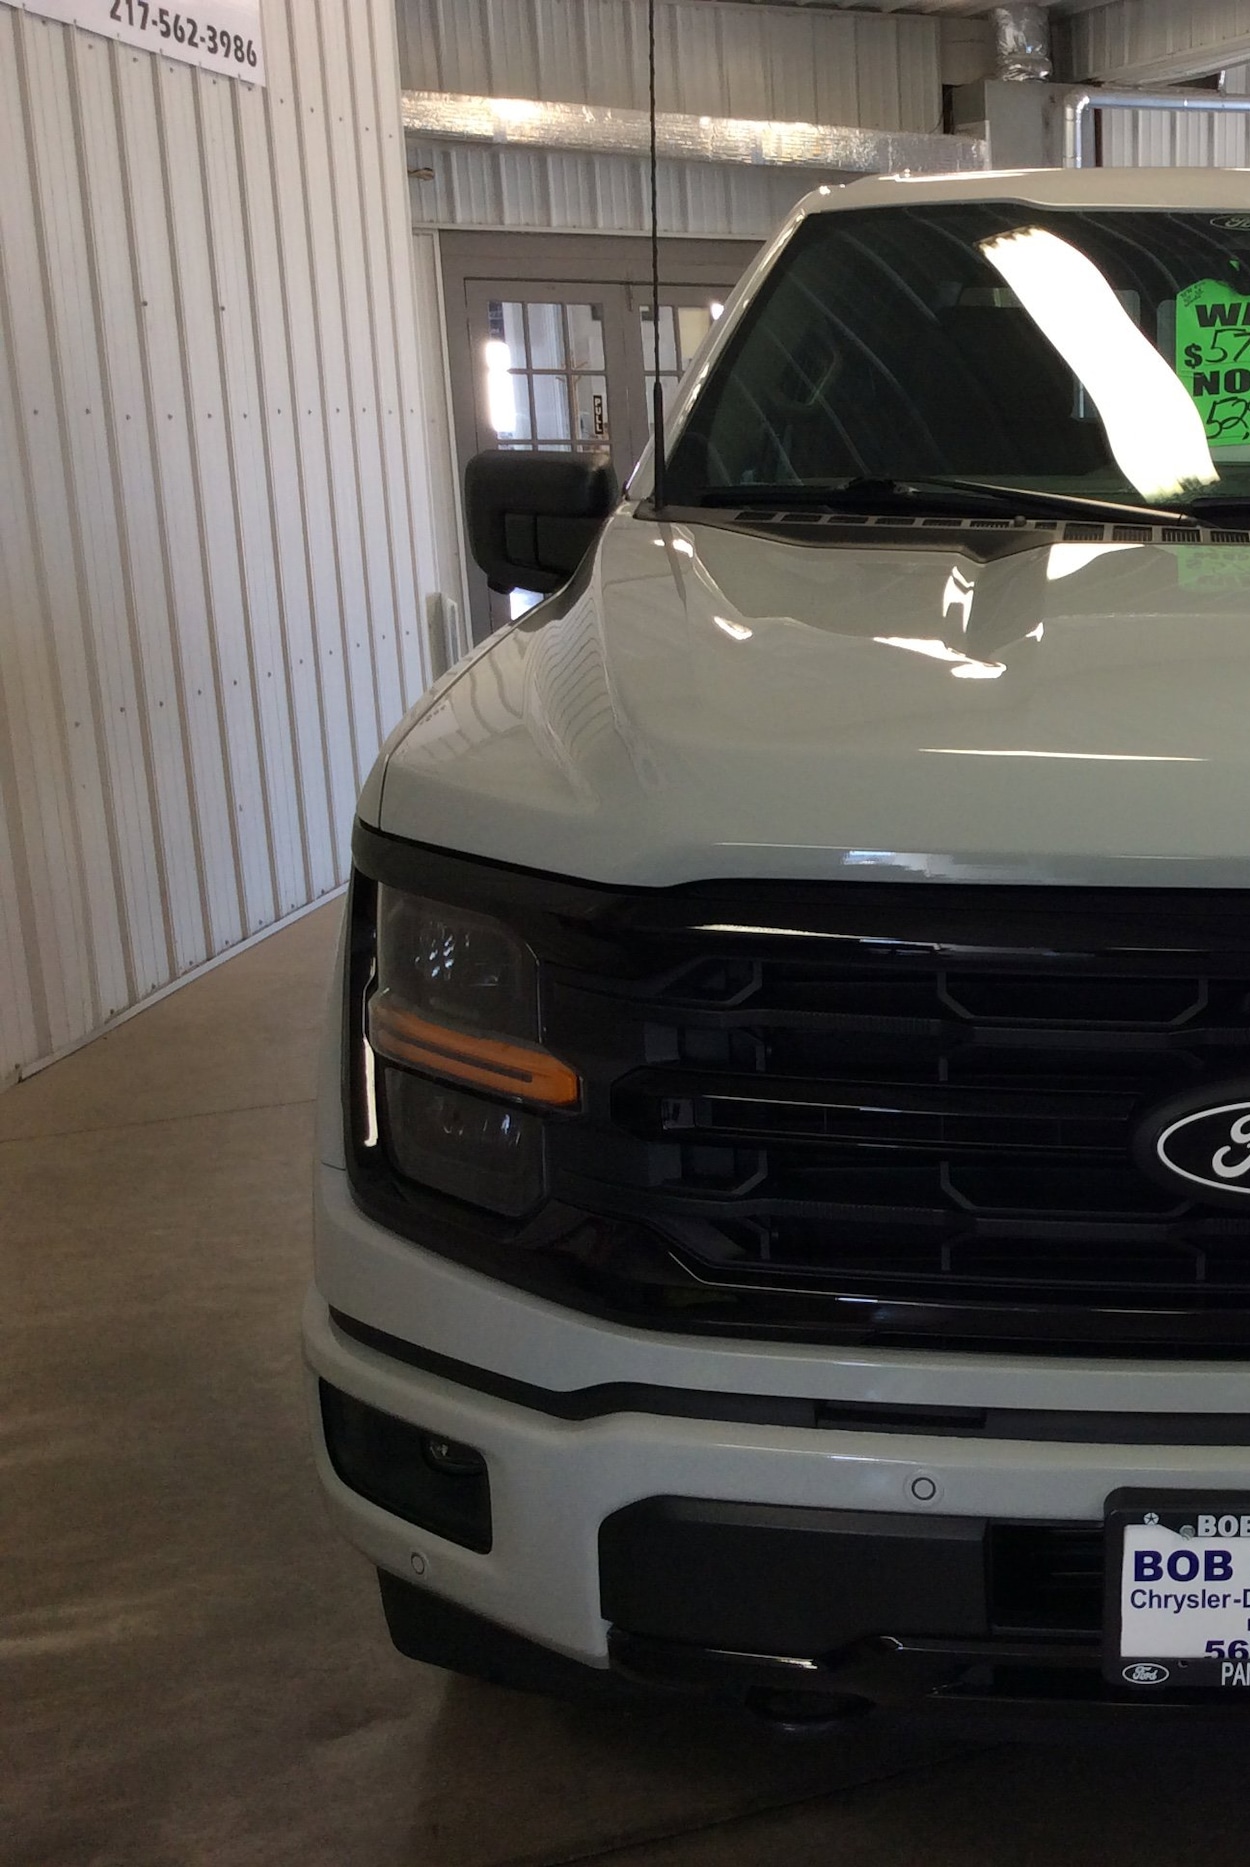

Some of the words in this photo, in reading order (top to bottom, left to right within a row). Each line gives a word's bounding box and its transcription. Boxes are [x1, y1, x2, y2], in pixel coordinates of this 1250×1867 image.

[110, 0, 257, 67] 217-562-3986
[594, 397, 602, 432] PULL
[1133, 1550, 1233, 1582] BOB
